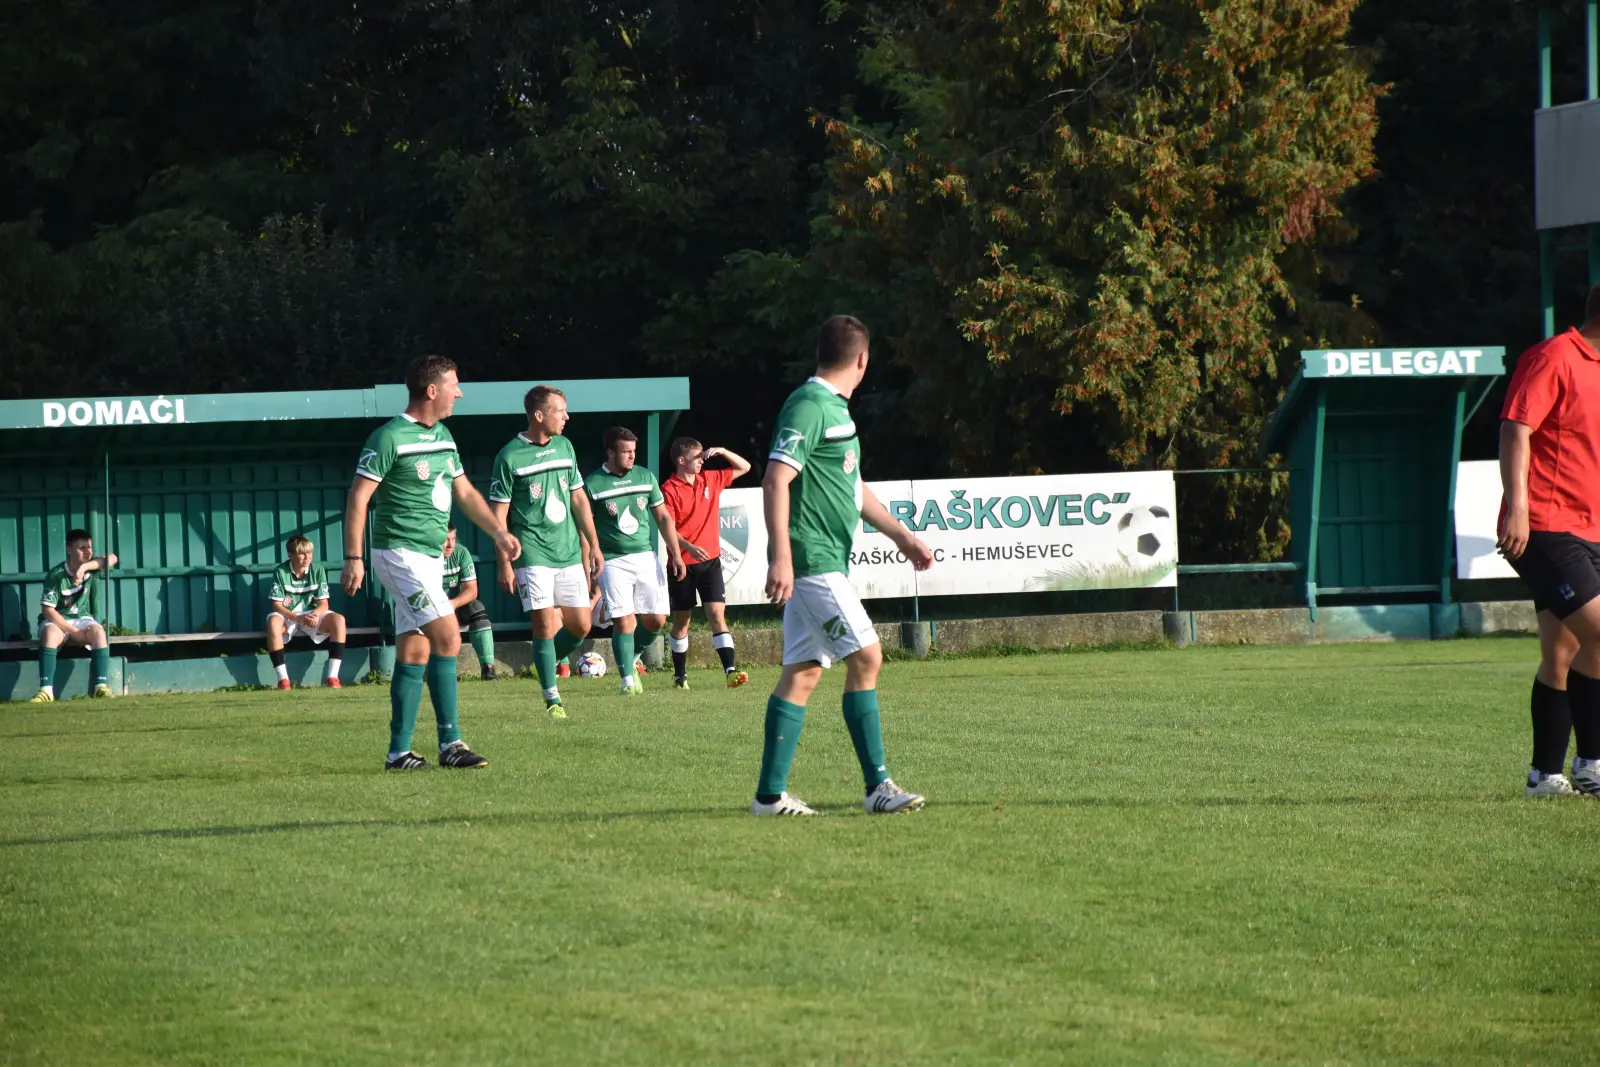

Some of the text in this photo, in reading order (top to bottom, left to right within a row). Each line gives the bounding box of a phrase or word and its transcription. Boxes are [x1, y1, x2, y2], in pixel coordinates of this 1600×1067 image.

[1325, 350, 1482, 376] DELEGAT
[43, 395, 185, 427] DOMAĆI
[720, 515, 743, 529] NK
[962, 542, 1074, 561] HEMUŠEVEC
